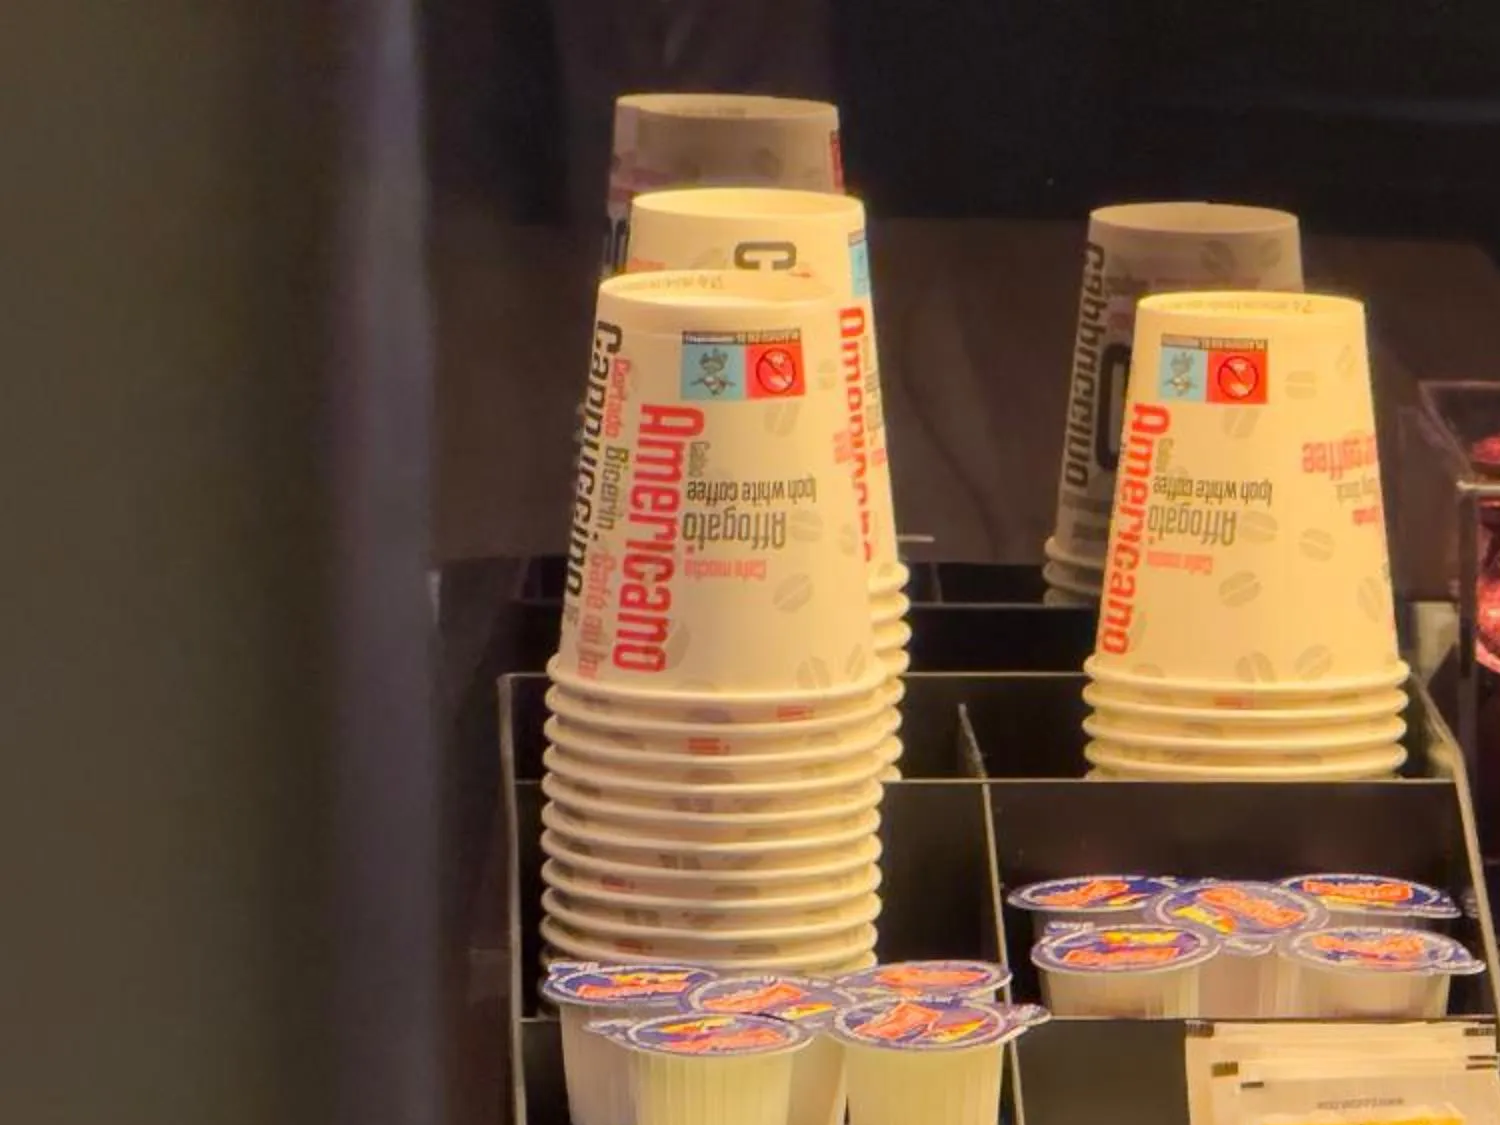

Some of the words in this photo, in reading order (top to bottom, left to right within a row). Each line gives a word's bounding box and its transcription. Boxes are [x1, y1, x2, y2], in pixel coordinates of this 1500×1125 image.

[687, 481, 739, 506] coffee
[742, 480, 785, 505] white
[1195, 479, 1237, 506] white
[612, 403, 705, 672] Americano
[682, 506, 787, 552] Affogato
[1102, 402, 1172, 655] Americano
[1147, 502, 1237, 546] Affogato
